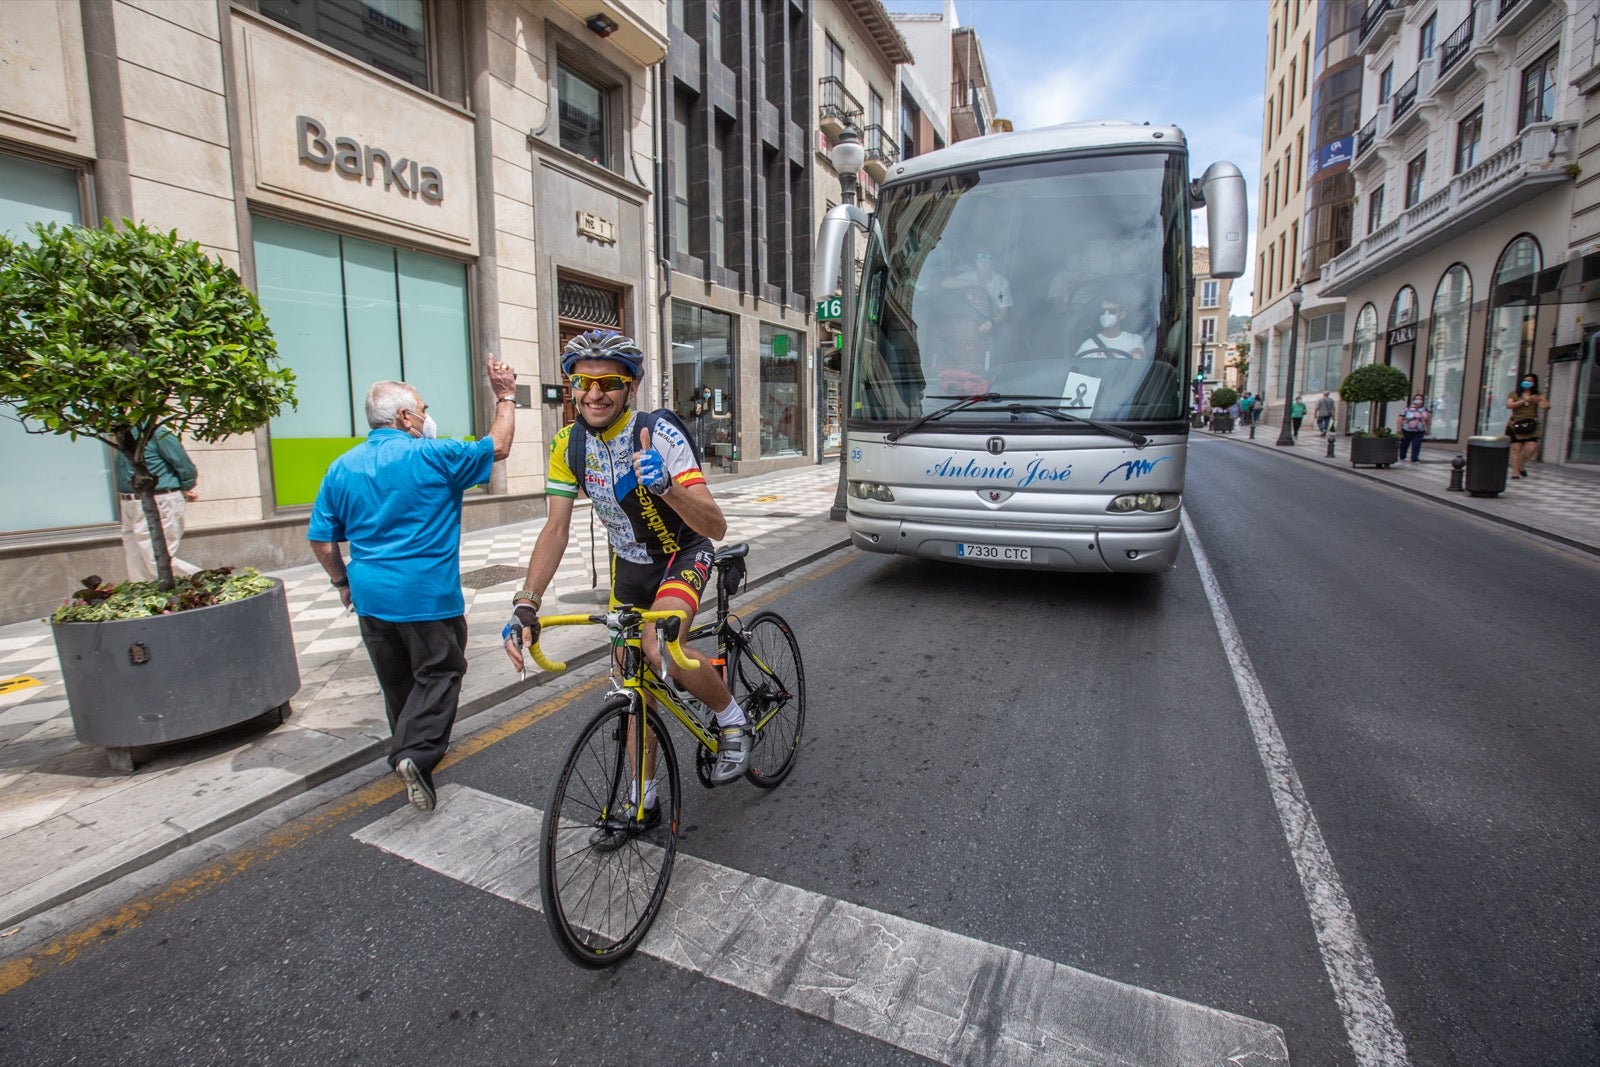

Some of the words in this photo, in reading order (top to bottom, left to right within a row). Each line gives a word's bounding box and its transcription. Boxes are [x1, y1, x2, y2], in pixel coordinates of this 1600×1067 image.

[296, 115, 444, 201] Bankia
[1390, 327, 1415, 346] ZARA
[852, 449, 861, 460] 35
[926, 456, 1015, 479] Antonio
[1017, 457, 1073, 488] José
[967, 545, 999, 558] 7330
[1004, 548, 1029, 560] CTC
